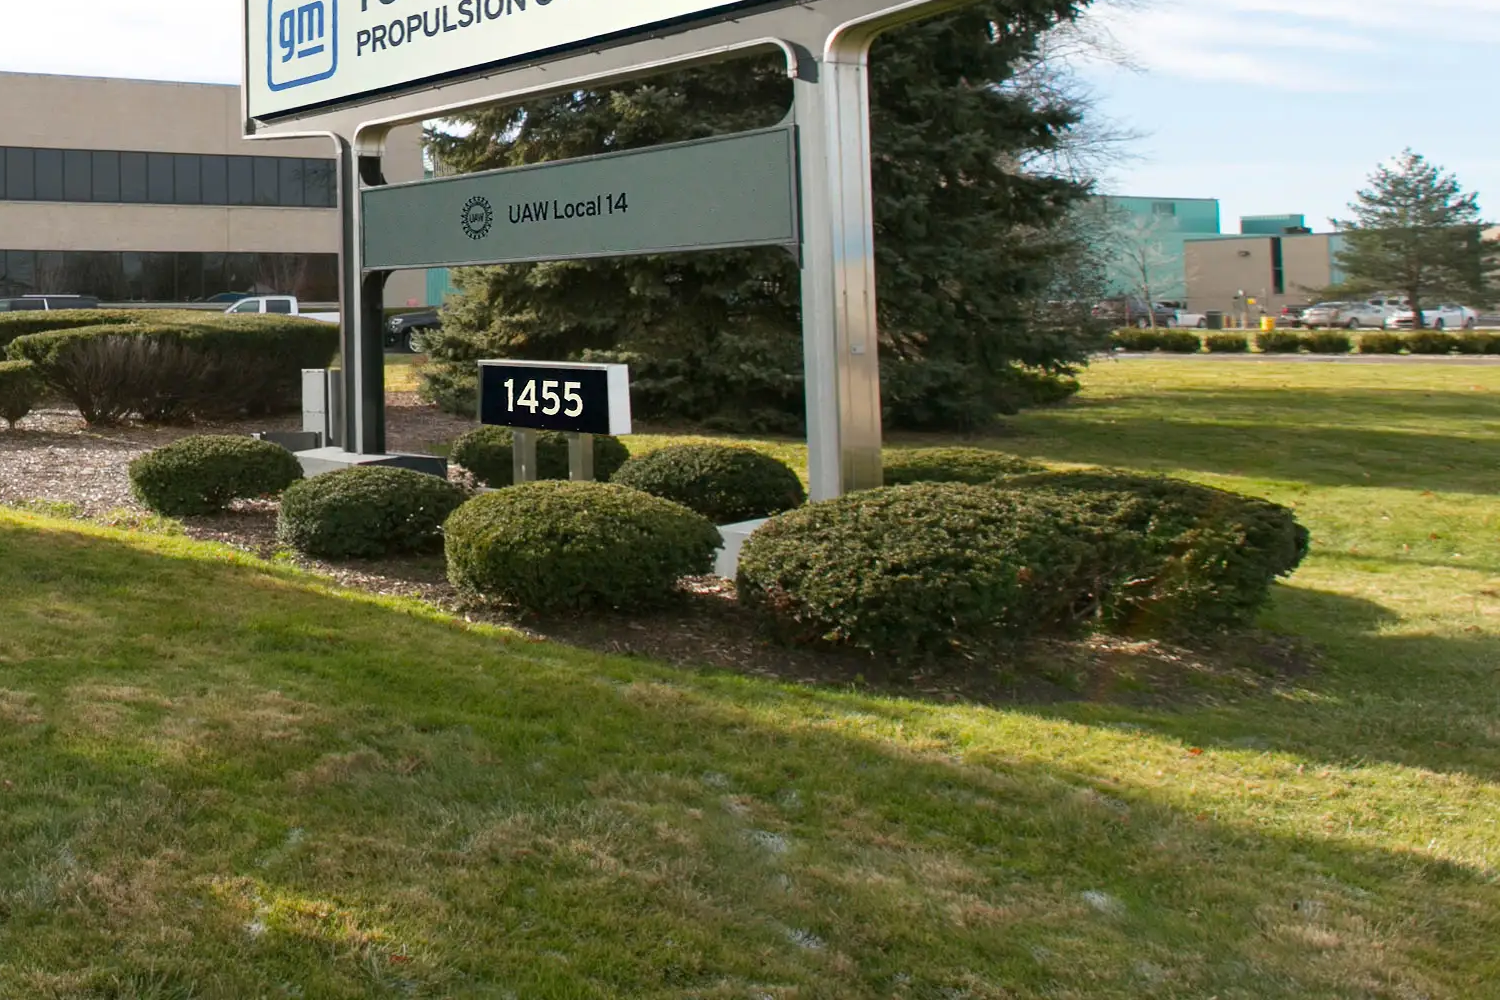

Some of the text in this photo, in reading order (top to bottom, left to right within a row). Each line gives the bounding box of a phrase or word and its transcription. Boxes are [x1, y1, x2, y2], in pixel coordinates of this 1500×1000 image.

[278, 0, 325, 64] gm
[508, 192, 629, 224] UAW Local 14
[503, 378, 584, 418] 1455
